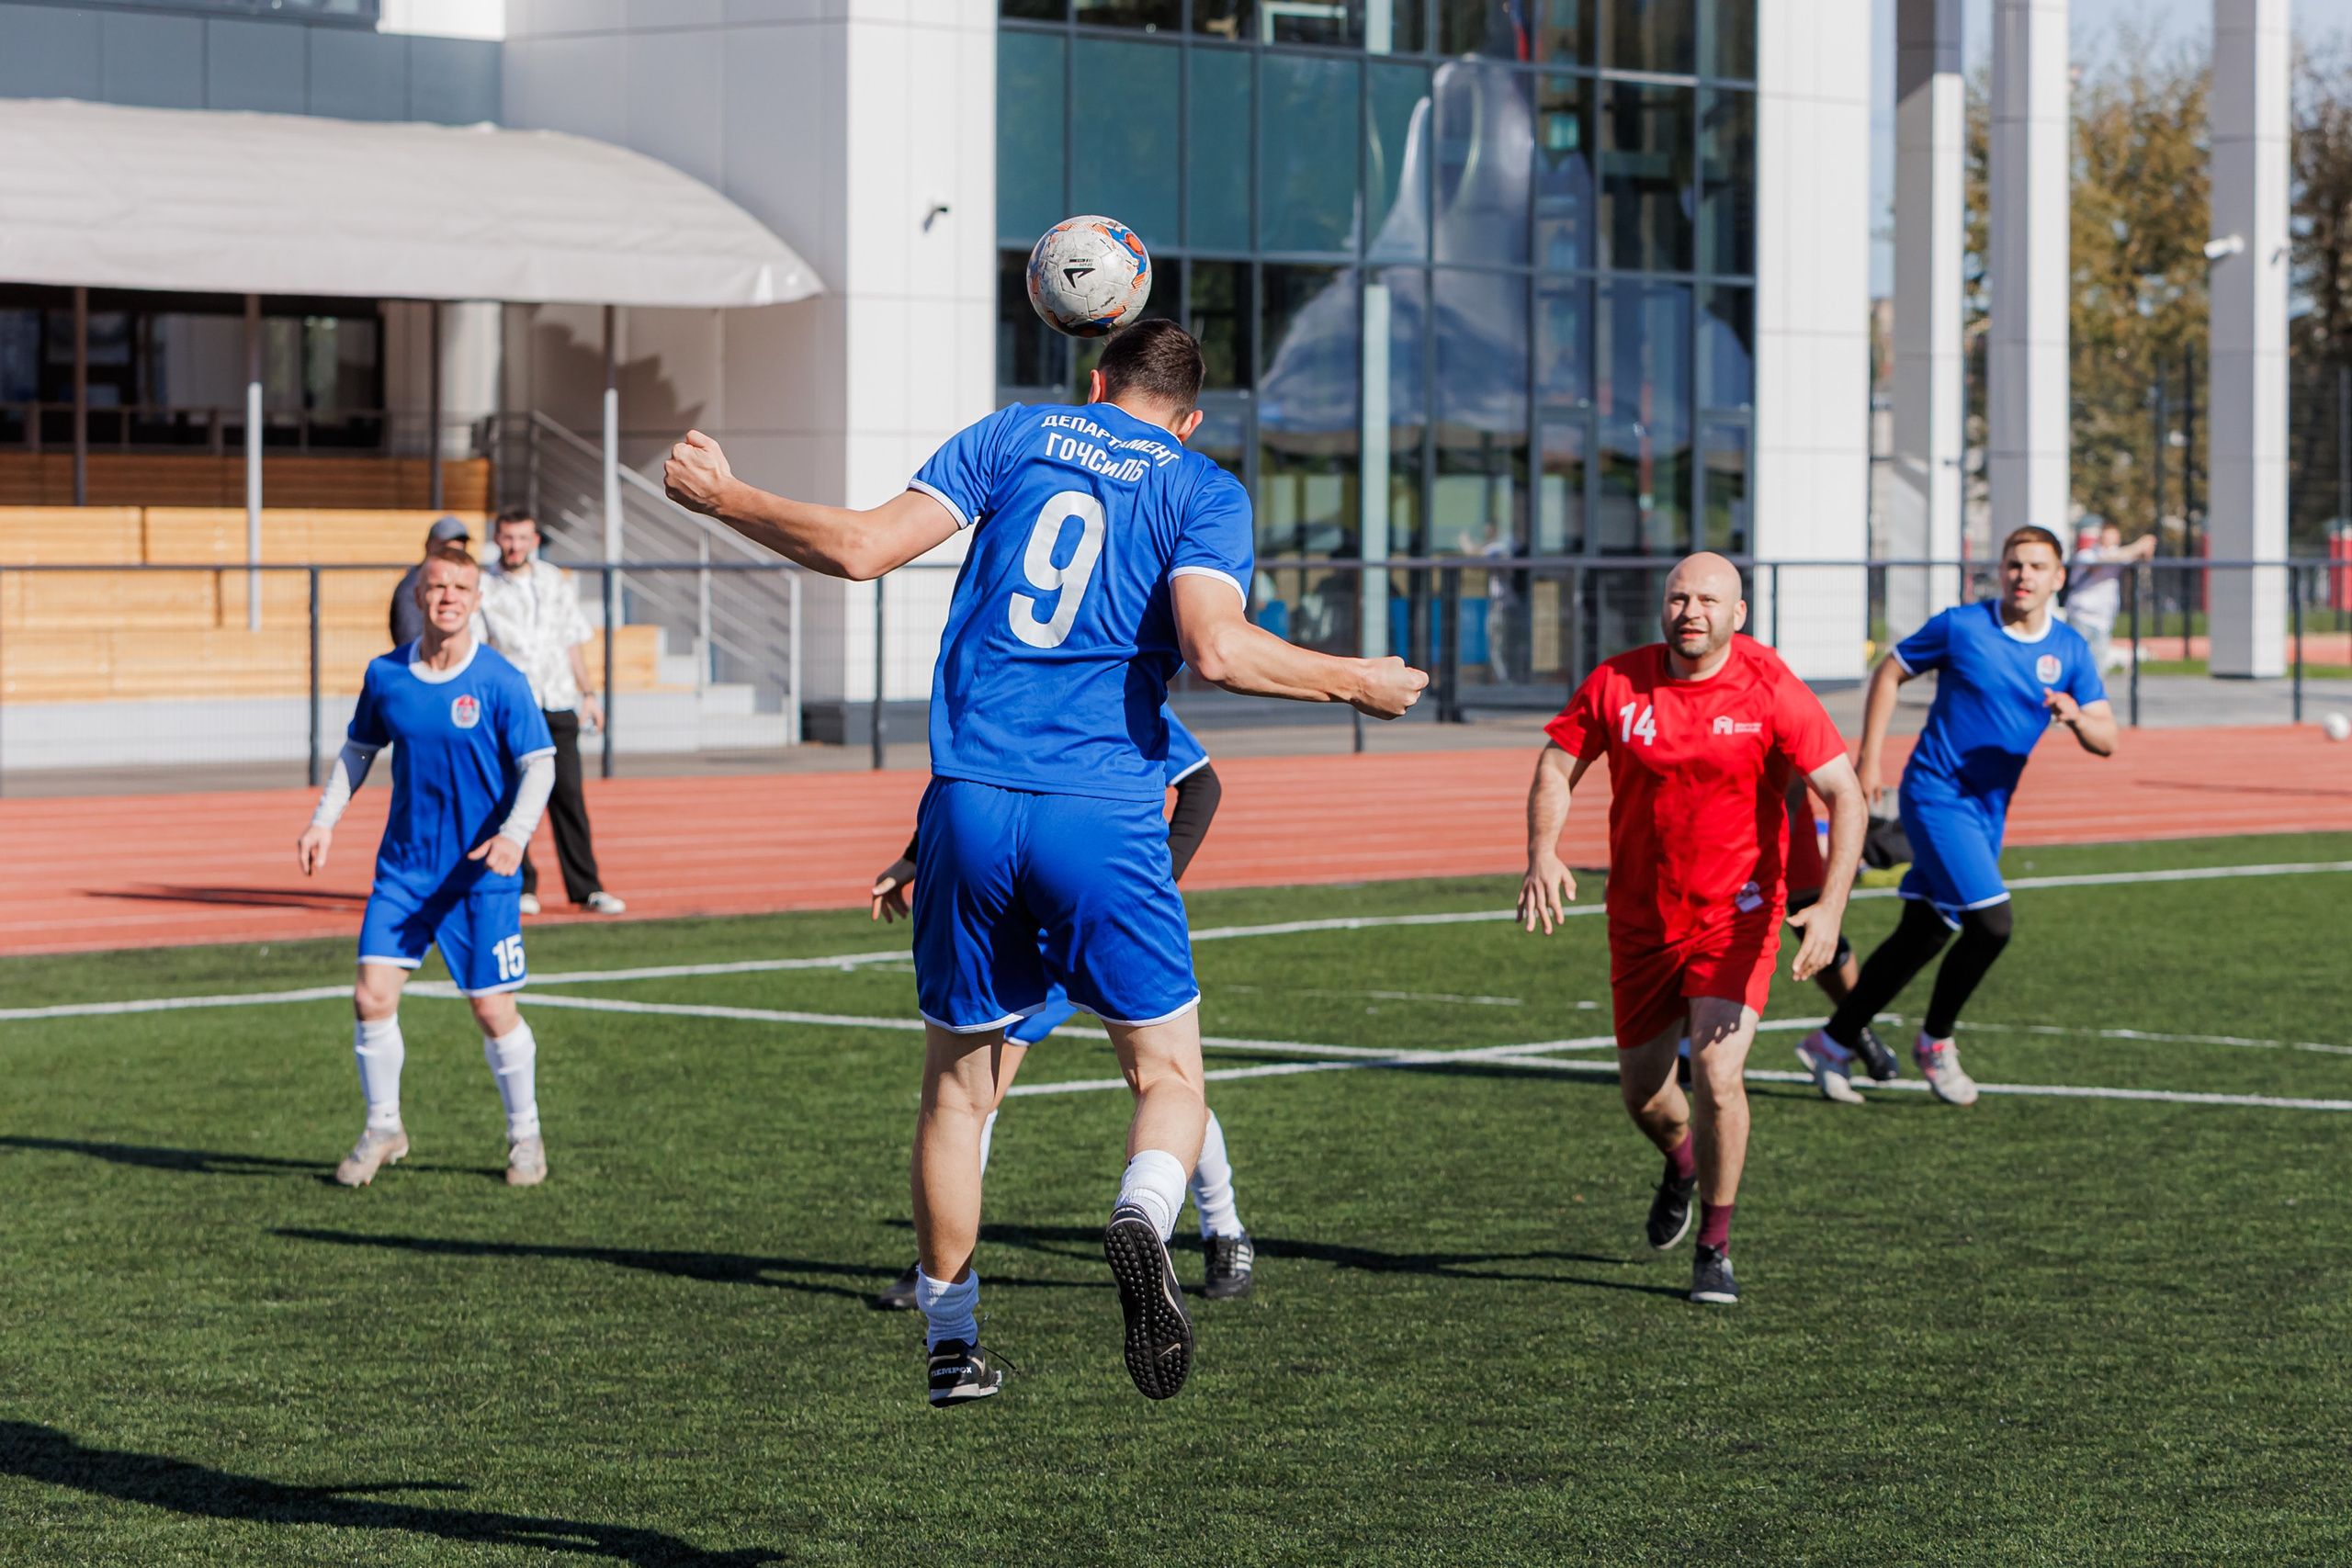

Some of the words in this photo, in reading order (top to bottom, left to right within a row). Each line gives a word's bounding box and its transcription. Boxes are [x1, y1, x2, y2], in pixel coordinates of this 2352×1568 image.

[1008, 491, 1107, 649] 9
[1619, 702, 1657, 746] 14
[492, 933, 526, 982] 15
